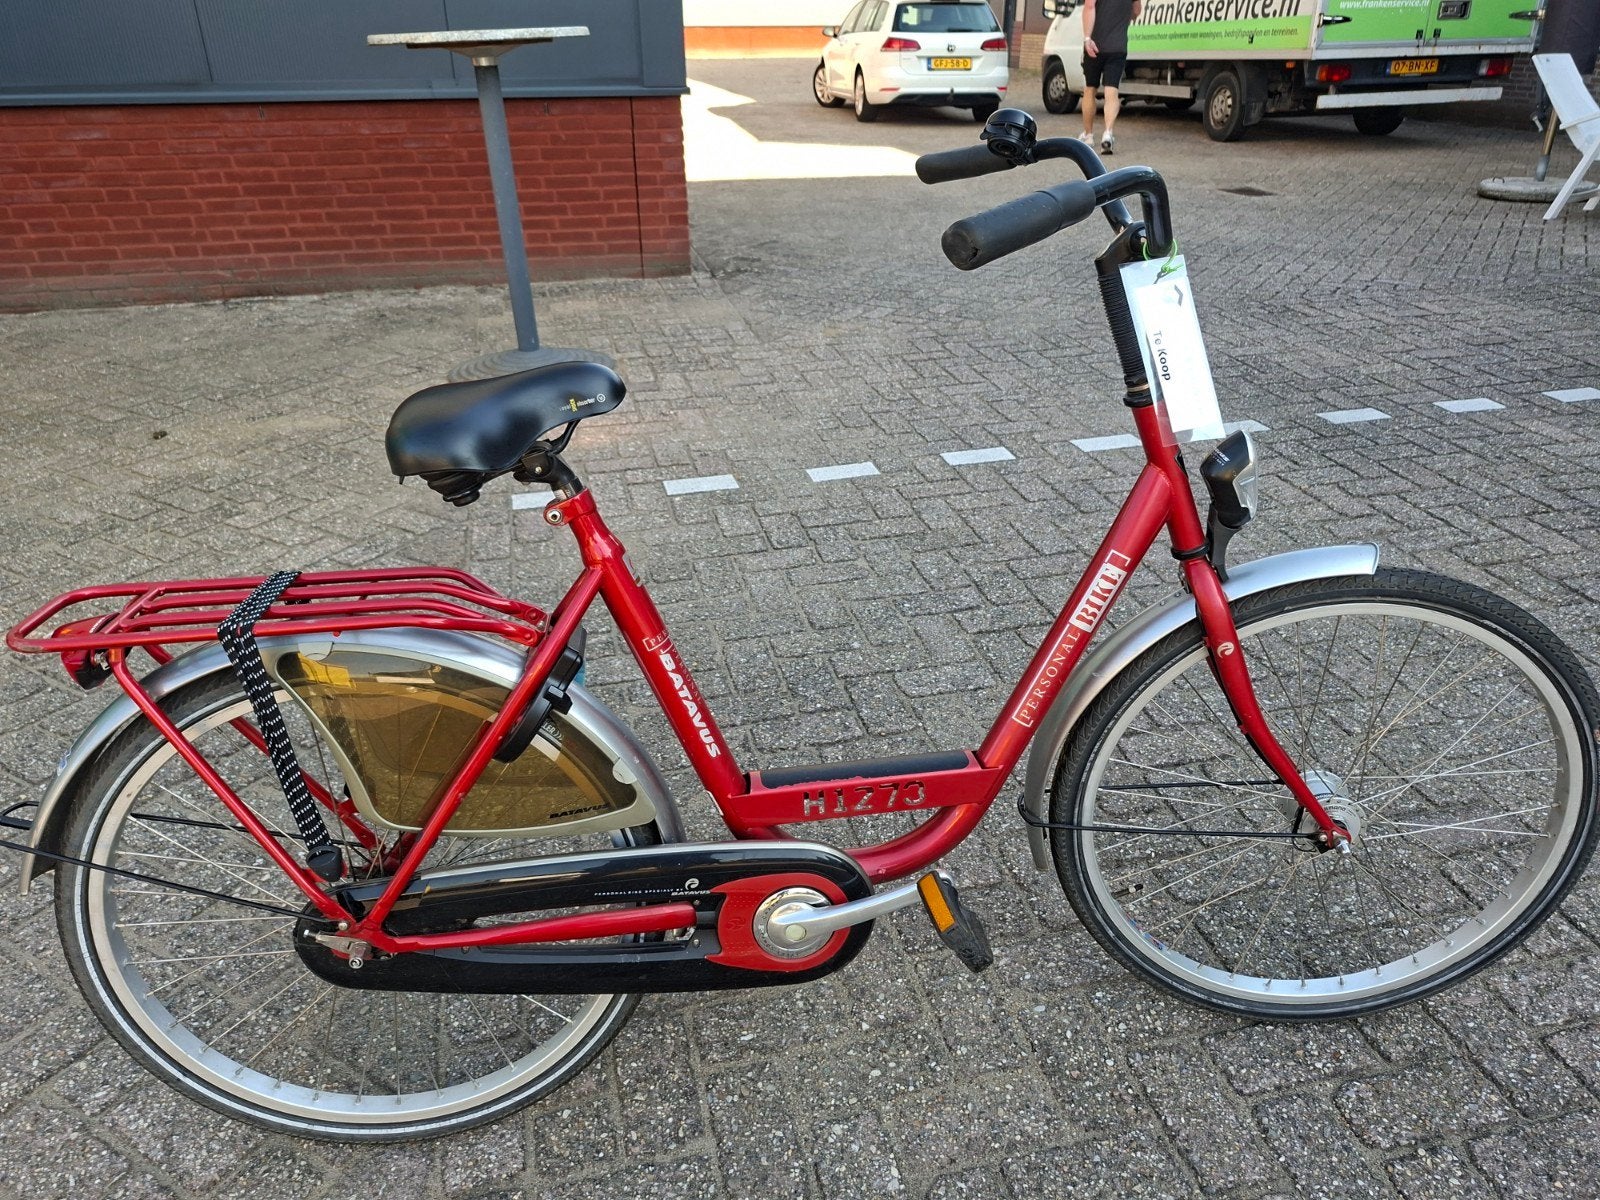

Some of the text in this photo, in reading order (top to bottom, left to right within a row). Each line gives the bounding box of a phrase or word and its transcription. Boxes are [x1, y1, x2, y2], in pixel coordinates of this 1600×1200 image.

[1133, 0, 1301, 26] .frankenservice.nl
[1340, 0, 1429, 9] www.frankenservice.nl
[933, 59, 969, 68] GFJ-58-D
[1393, 60, 1436, 72] 07-BN-XF
[1153, 330, 1171, 381] Te Koop
[1019, 566, 1123, 721] PERSONAL BIKE
[659, 653, 721, 758] BATAVUS
[550, 803, 609, 819] BATAVUS
